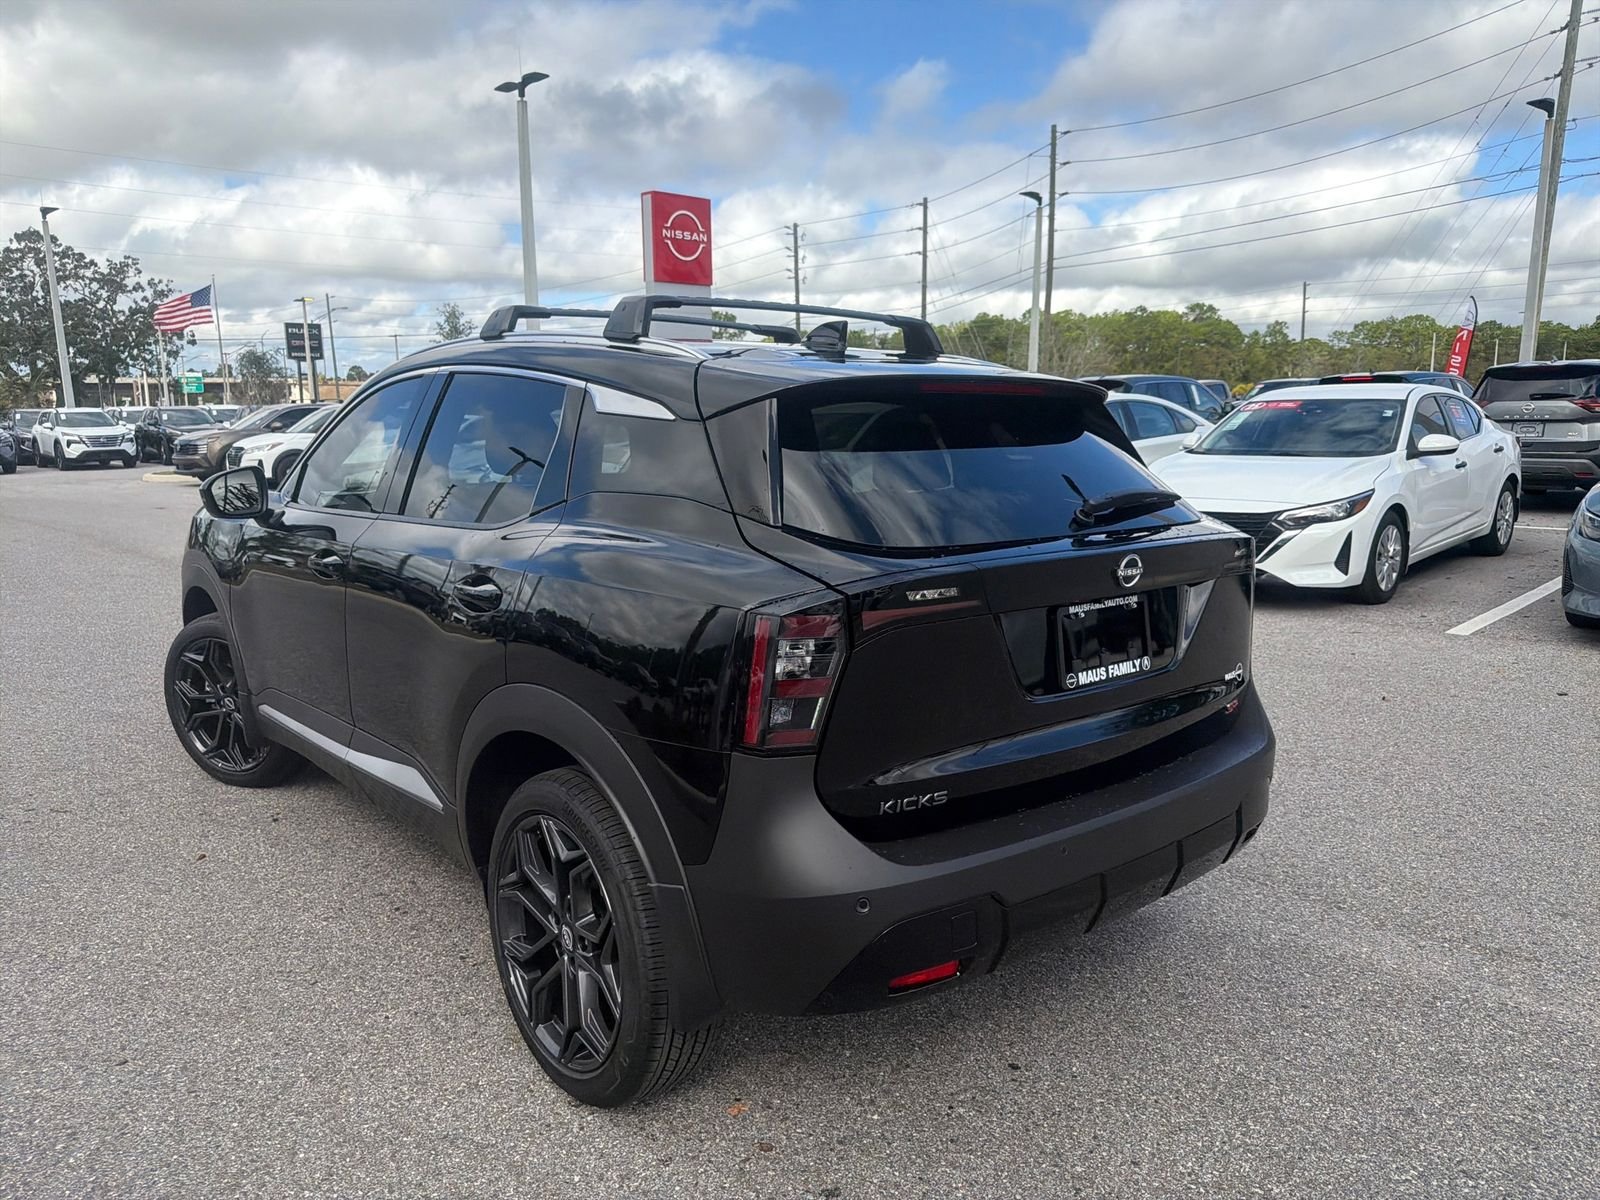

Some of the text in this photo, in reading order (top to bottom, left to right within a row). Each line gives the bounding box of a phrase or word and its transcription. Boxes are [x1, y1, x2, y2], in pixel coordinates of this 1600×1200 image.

[662, 229, 707, 242] NISSAN
[288, 327, 319, 335] BUCK
[1117, 568, 1143, 577] NISSAN
[1068, 595, 1139, 614] MAUSFAMILYAUTO.COM
[1078, 658, 1141, 686] MAUS FAMILY
[879, 790, 949, 815] KICKS
